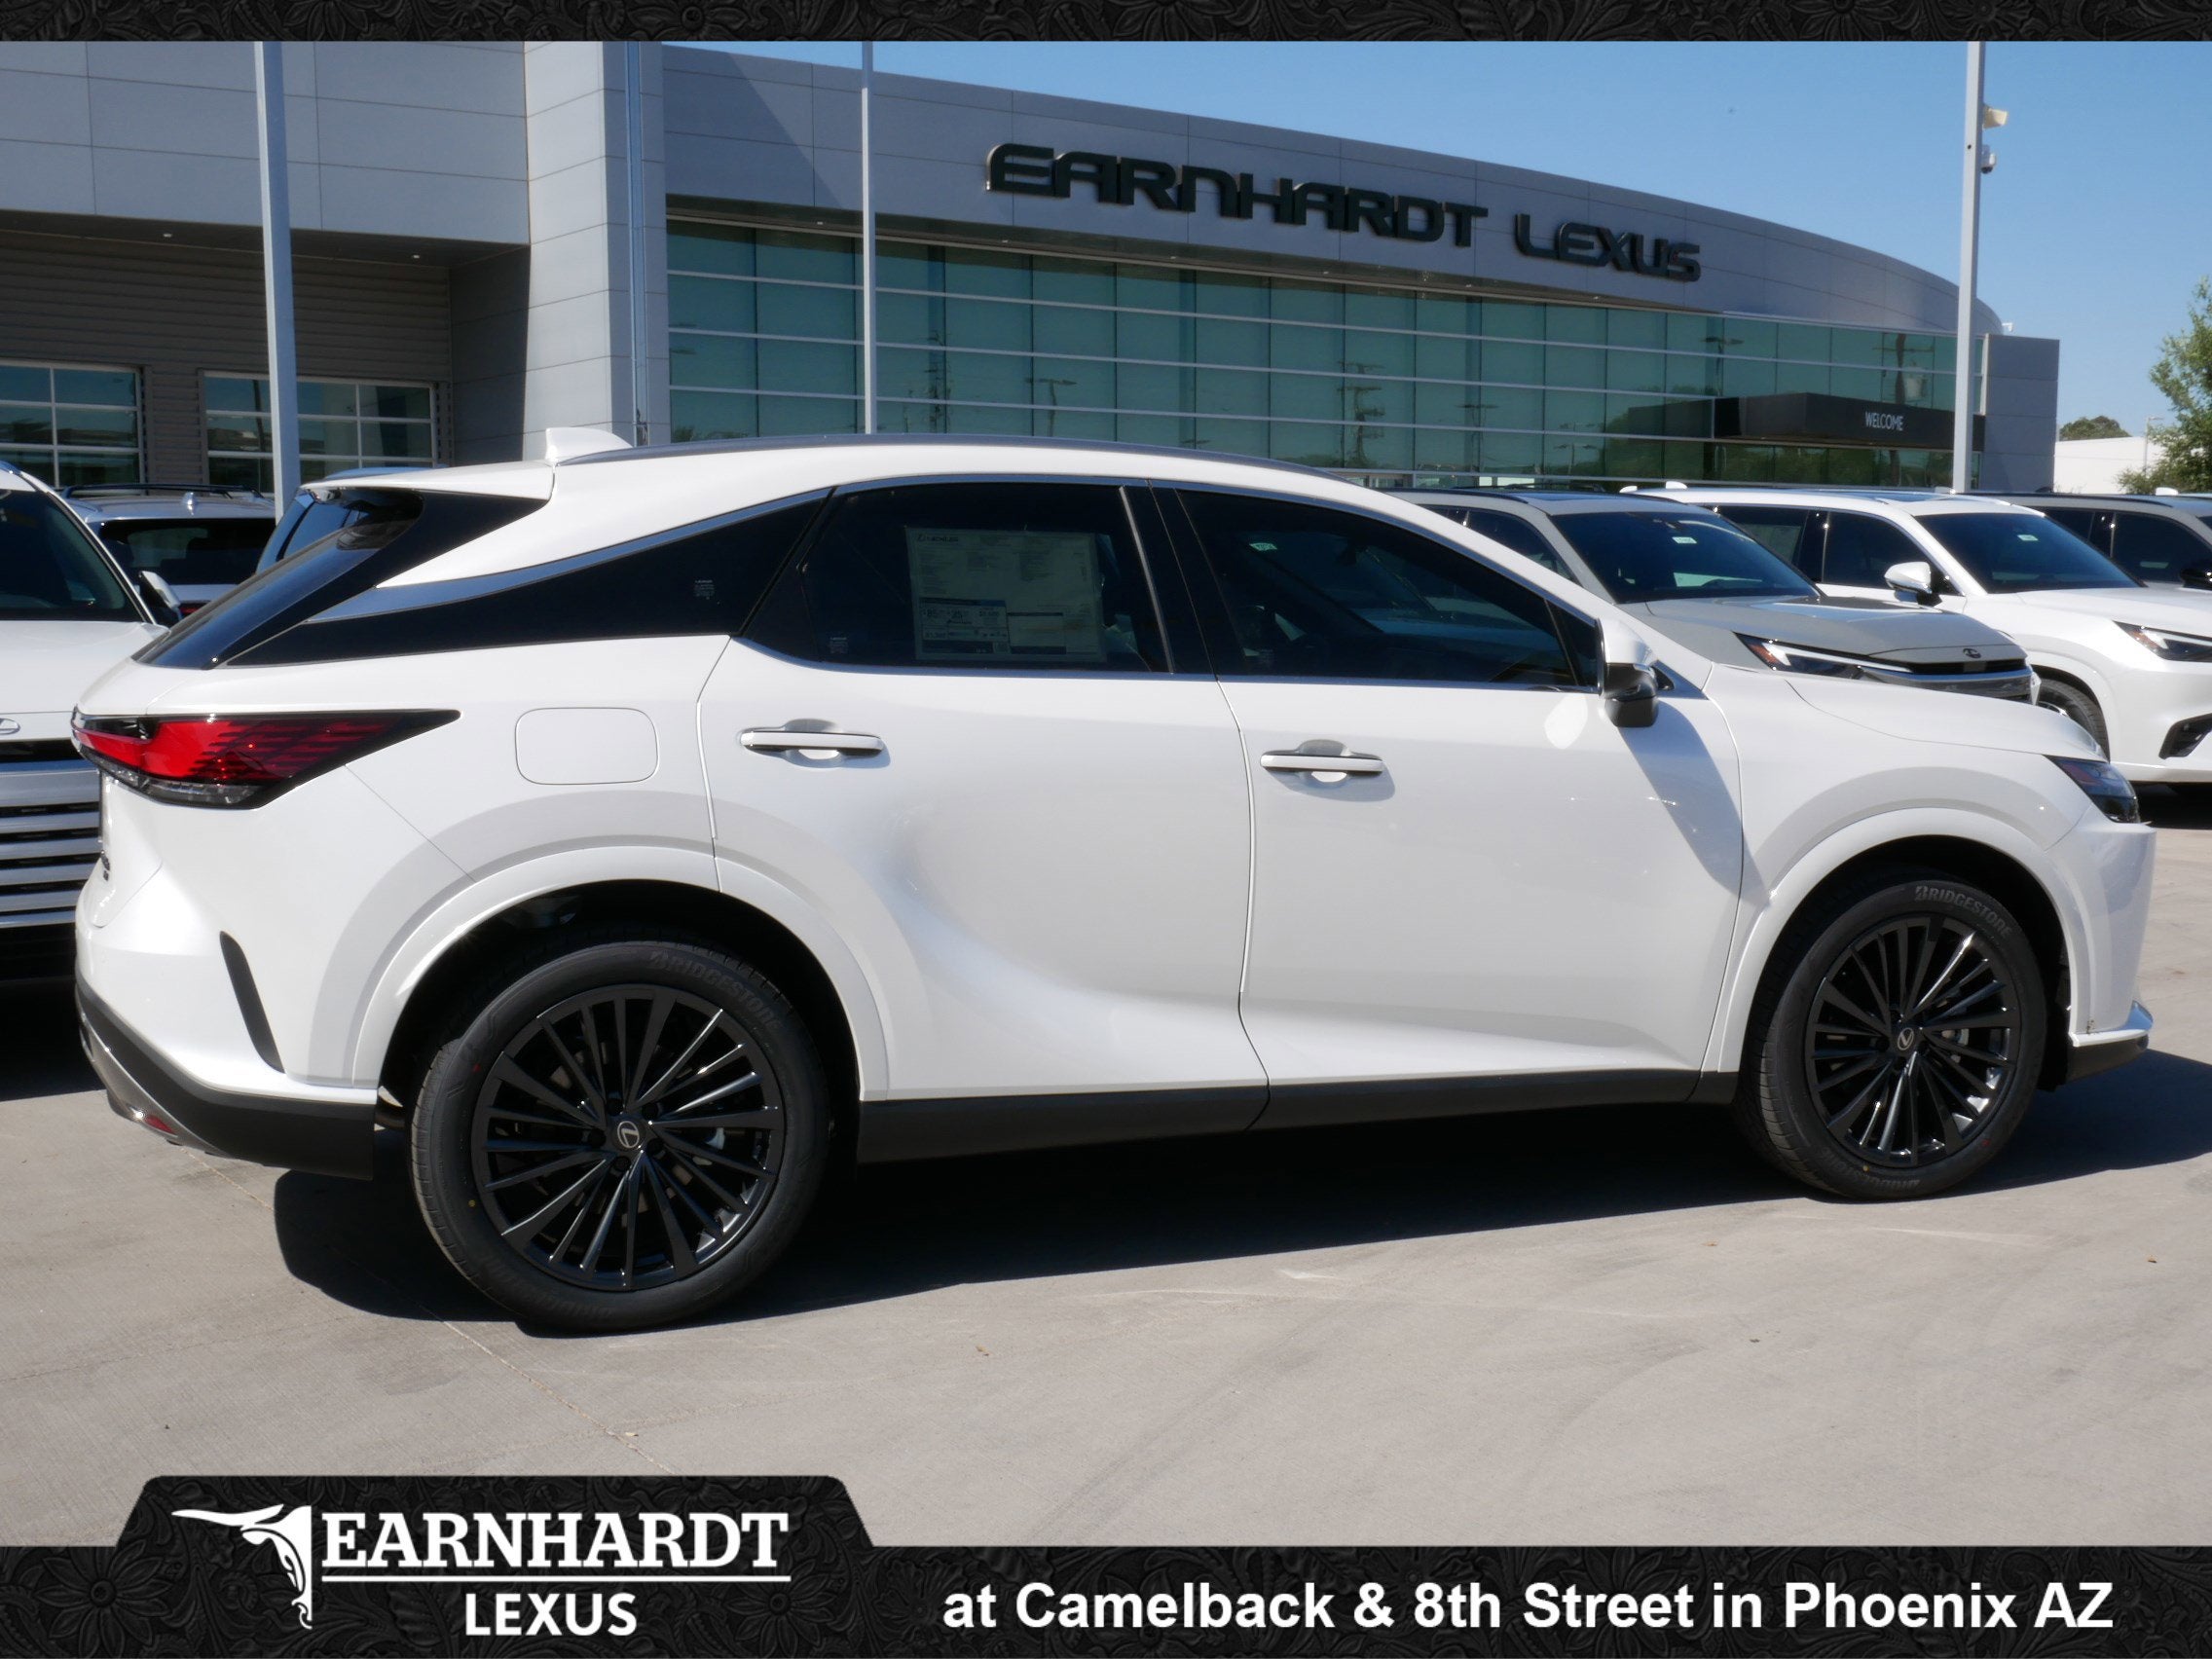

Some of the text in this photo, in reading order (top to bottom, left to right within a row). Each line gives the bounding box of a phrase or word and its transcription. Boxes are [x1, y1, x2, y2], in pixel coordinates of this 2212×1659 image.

[986, 143, 1702, 282] EARNHARDT LEXUS
[1864, 411, 1904, 431] WELCOME
[1914, 885, 2012, 939] BRIDGESTONE
